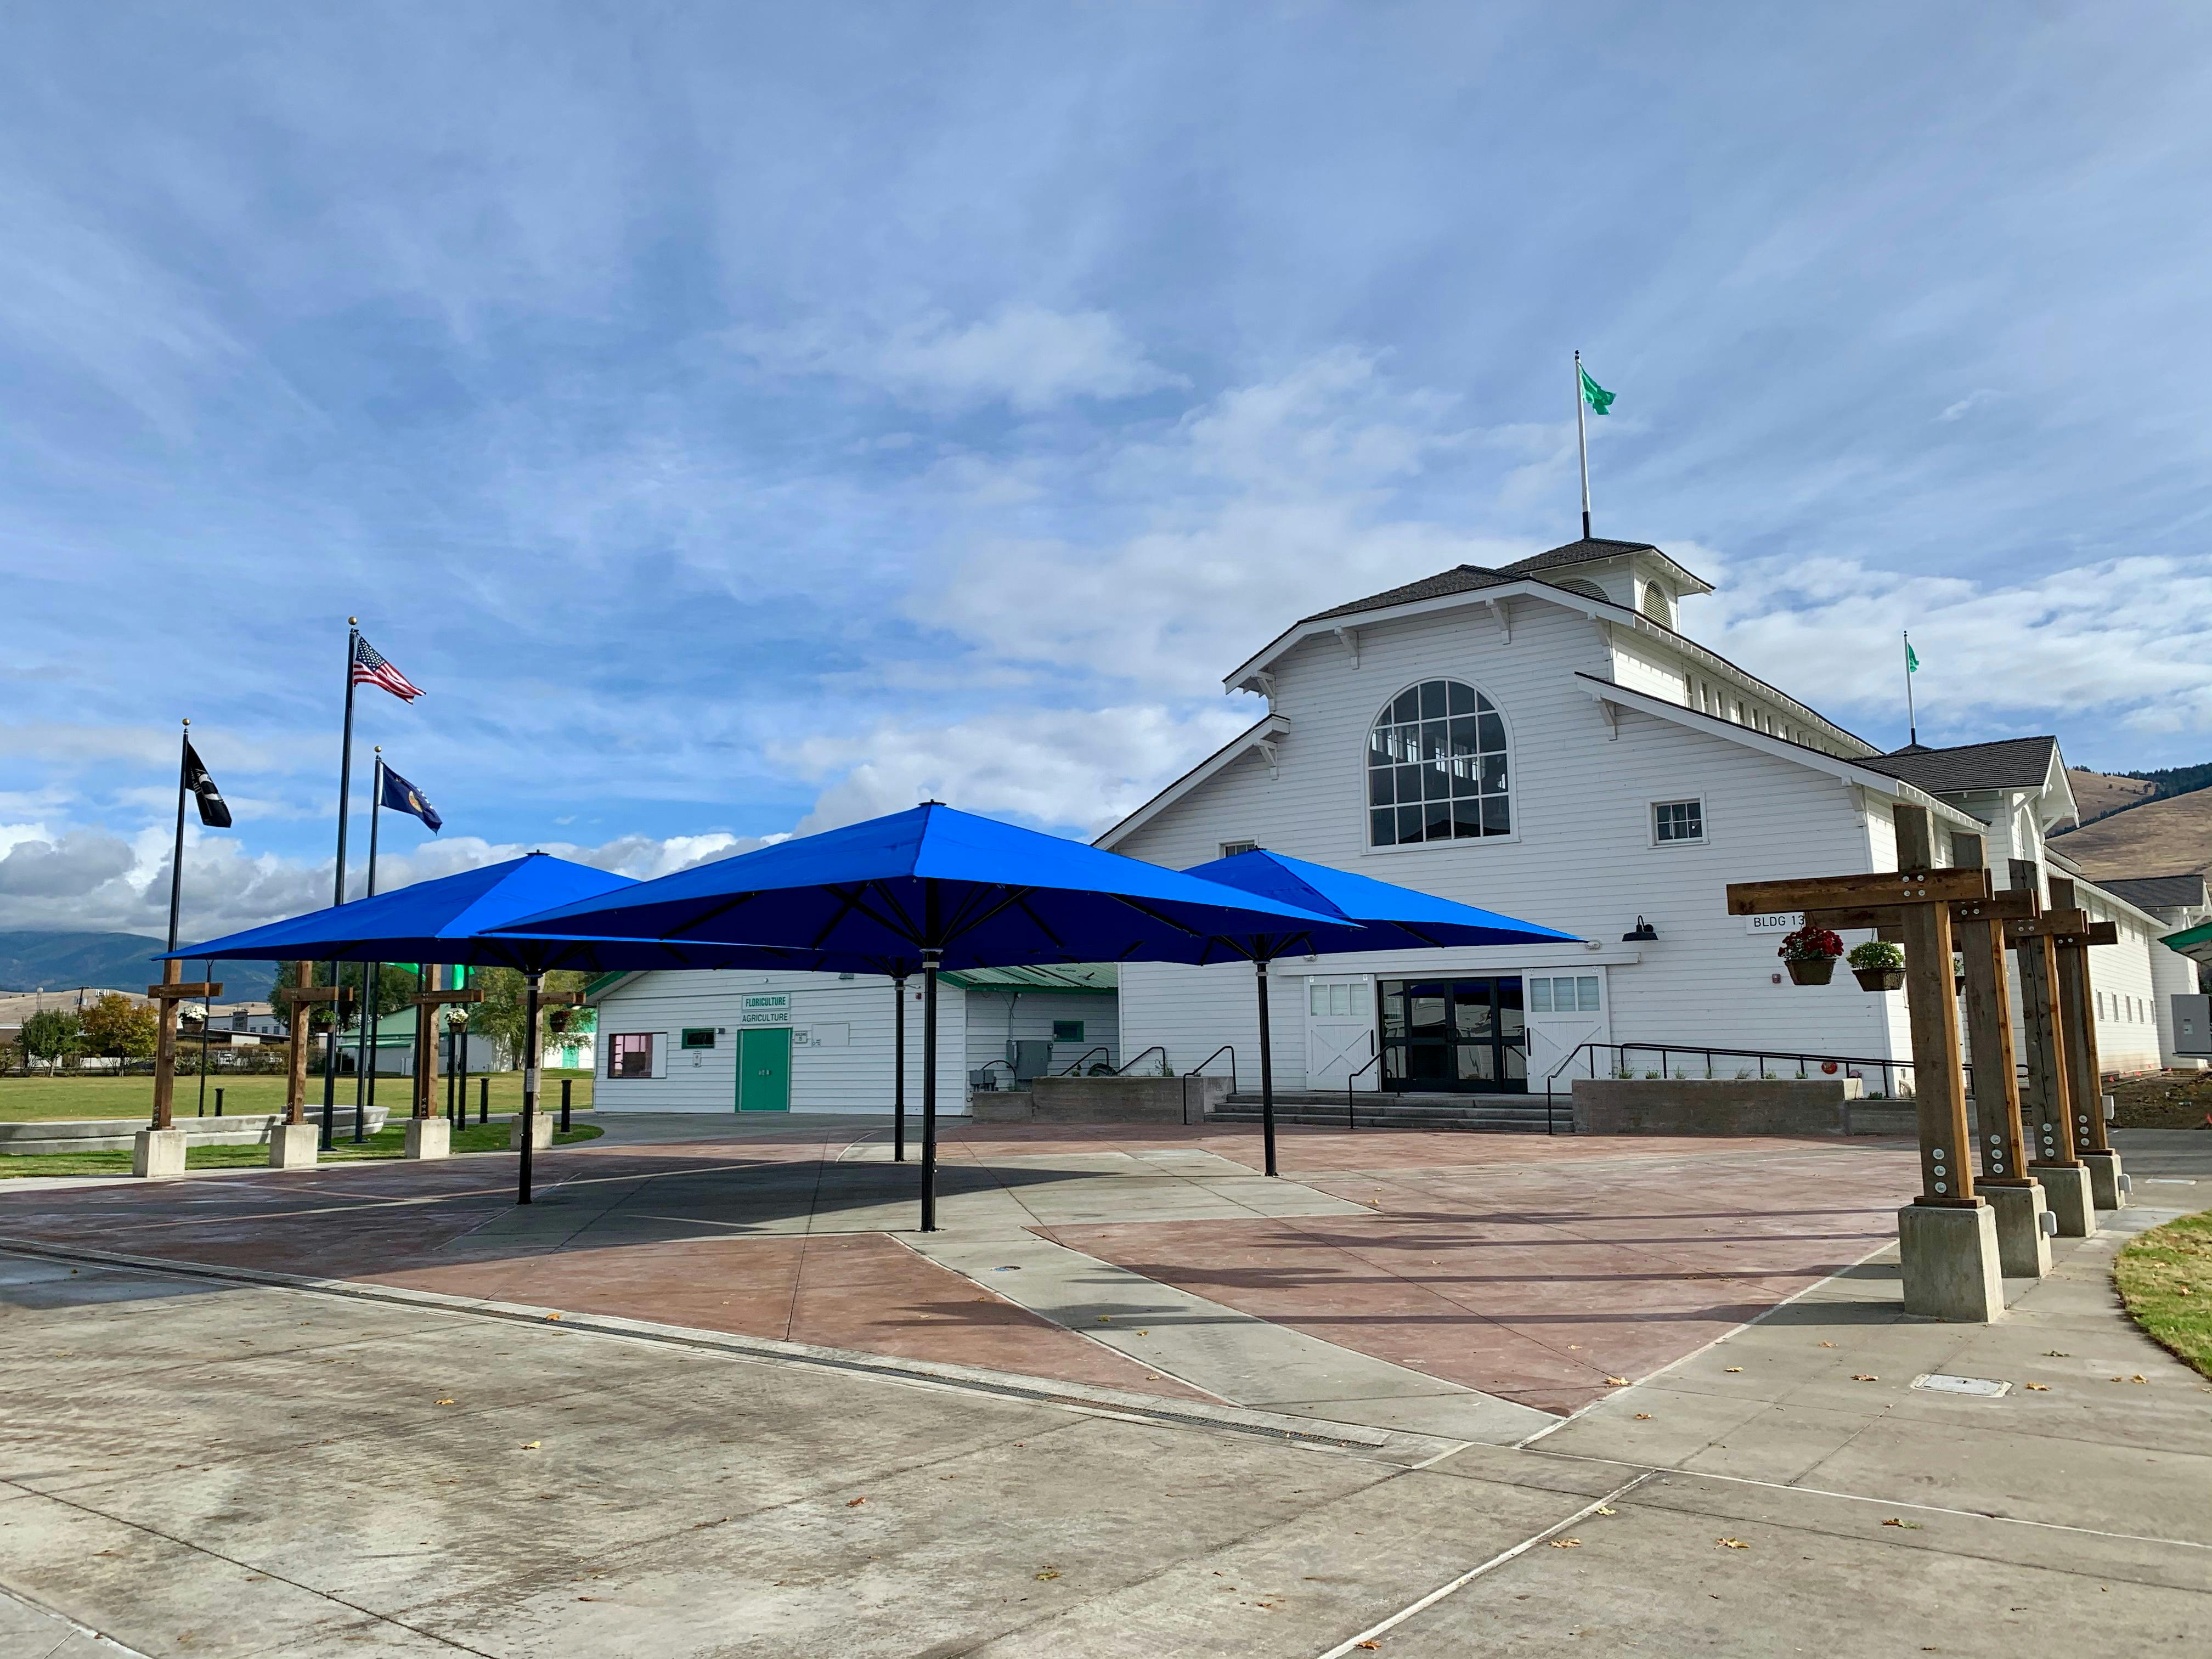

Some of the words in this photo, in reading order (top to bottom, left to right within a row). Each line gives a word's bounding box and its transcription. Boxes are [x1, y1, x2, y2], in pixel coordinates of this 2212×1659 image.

[1754, 916, 1786, 927] BLDG
[1791, 915, 1804, 926] 13
[746, 996, 786, 1007] FLORICULTURE
[742, 1013, 788, 1023] AGRICULTURE
